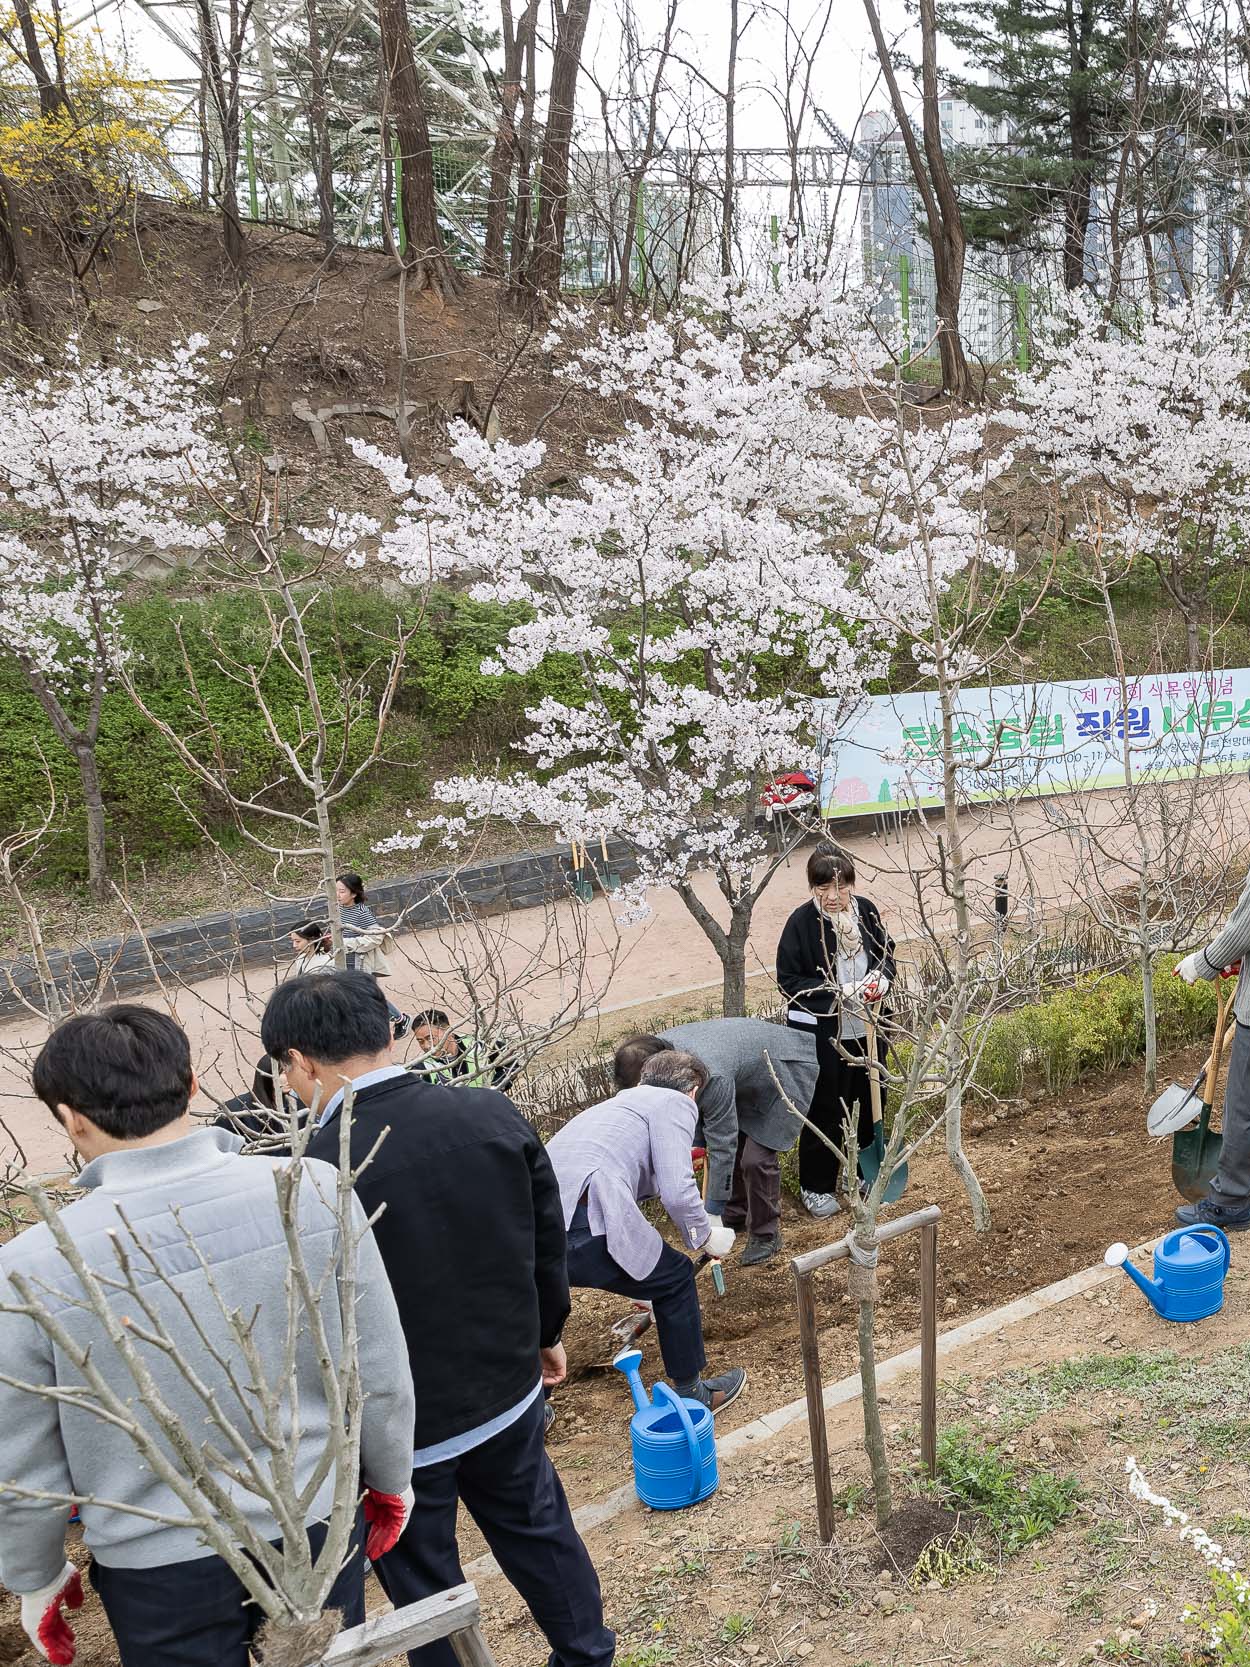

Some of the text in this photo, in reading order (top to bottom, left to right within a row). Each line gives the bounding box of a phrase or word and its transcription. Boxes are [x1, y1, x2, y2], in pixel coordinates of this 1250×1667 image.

[1148, 679, 1197, 698] 식목일
[1202, 676, 1233, 695] 기념
[1076, 706, 1151, 741] 직원
